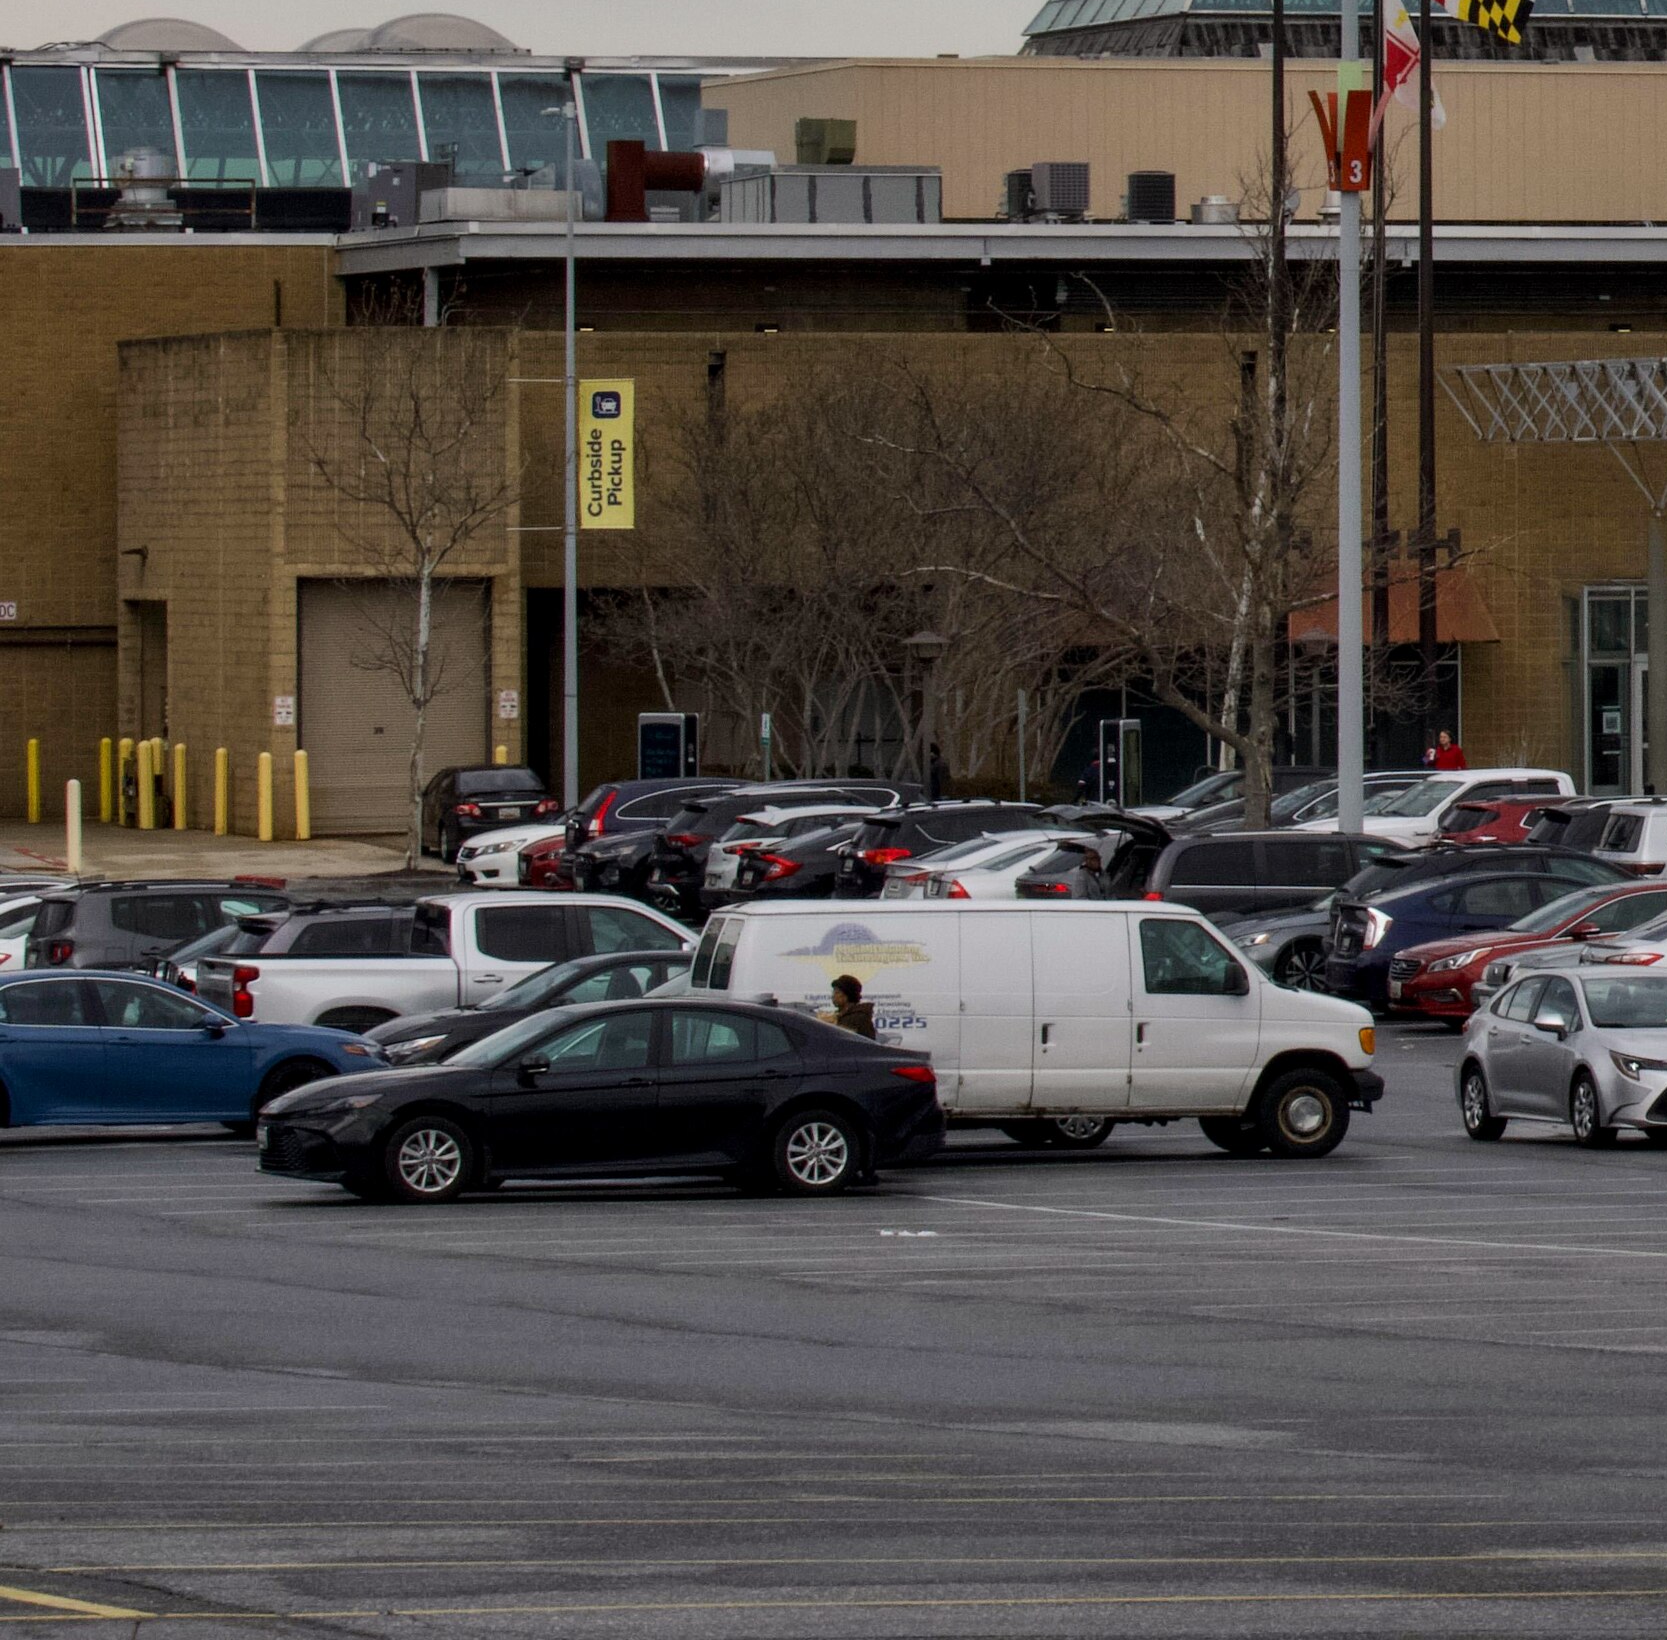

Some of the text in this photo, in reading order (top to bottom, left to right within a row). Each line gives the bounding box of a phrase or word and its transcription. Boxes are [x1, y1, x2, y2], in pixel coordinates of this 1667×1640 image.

[1349, 159, 1363, 183] 3
[588, 428, 603, 517] Curbside
[607, 439, 626, 507] Pickup
